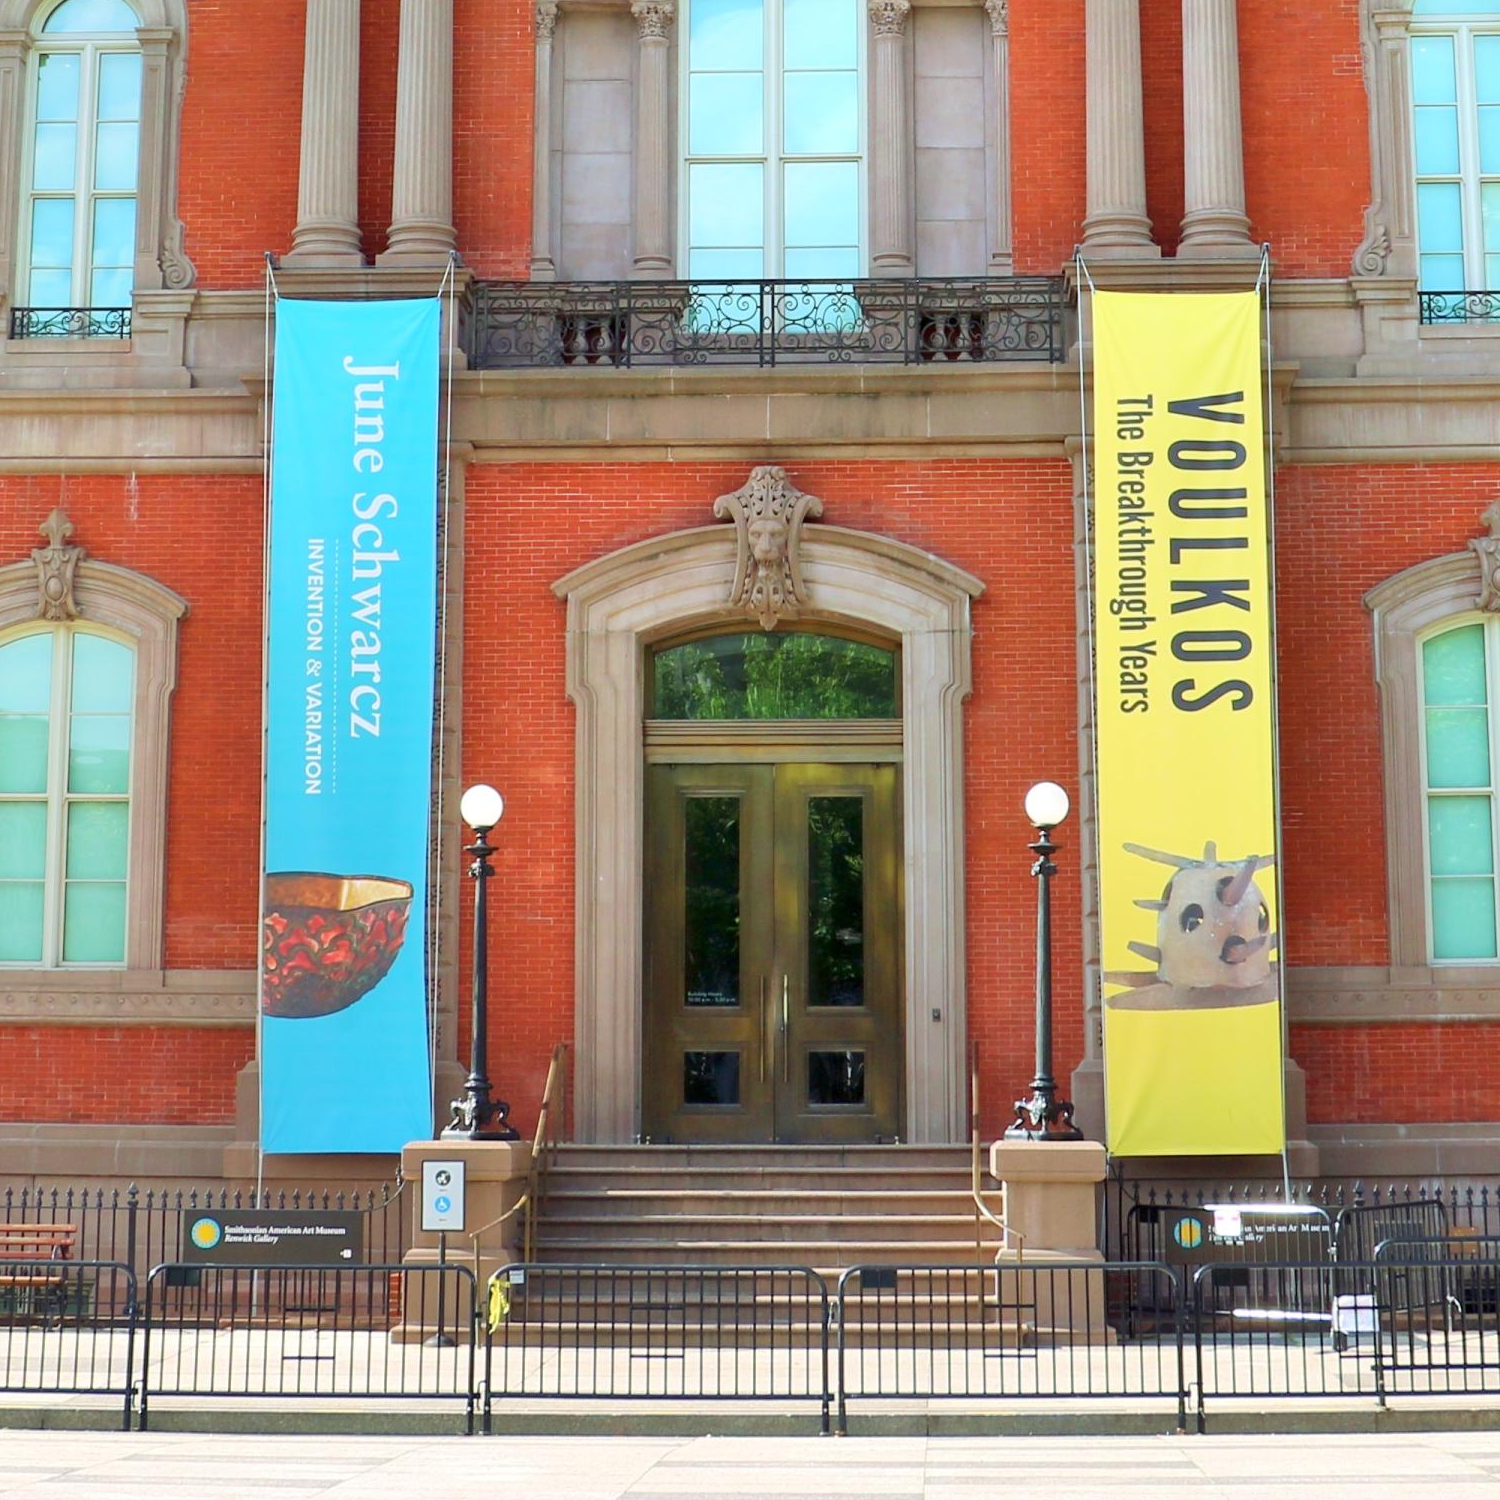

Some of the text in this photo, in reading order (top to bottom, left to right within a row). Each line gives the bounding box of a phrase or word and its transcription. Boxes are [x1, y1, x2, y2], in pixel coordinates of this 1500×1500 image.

[304, 537, 325, 795] INVENTION & VARIATION
[342, 355, 400, 739] June Schwarcz
[1109, 394, 1157, 713] The Breakthrough Years
[1167, 390, 1253, 712] VOULKOS
[224, 1225, 346, 1235] Smithsonian American Art Museum
[224, 1234, 279, 1245] Renwick Gallery
